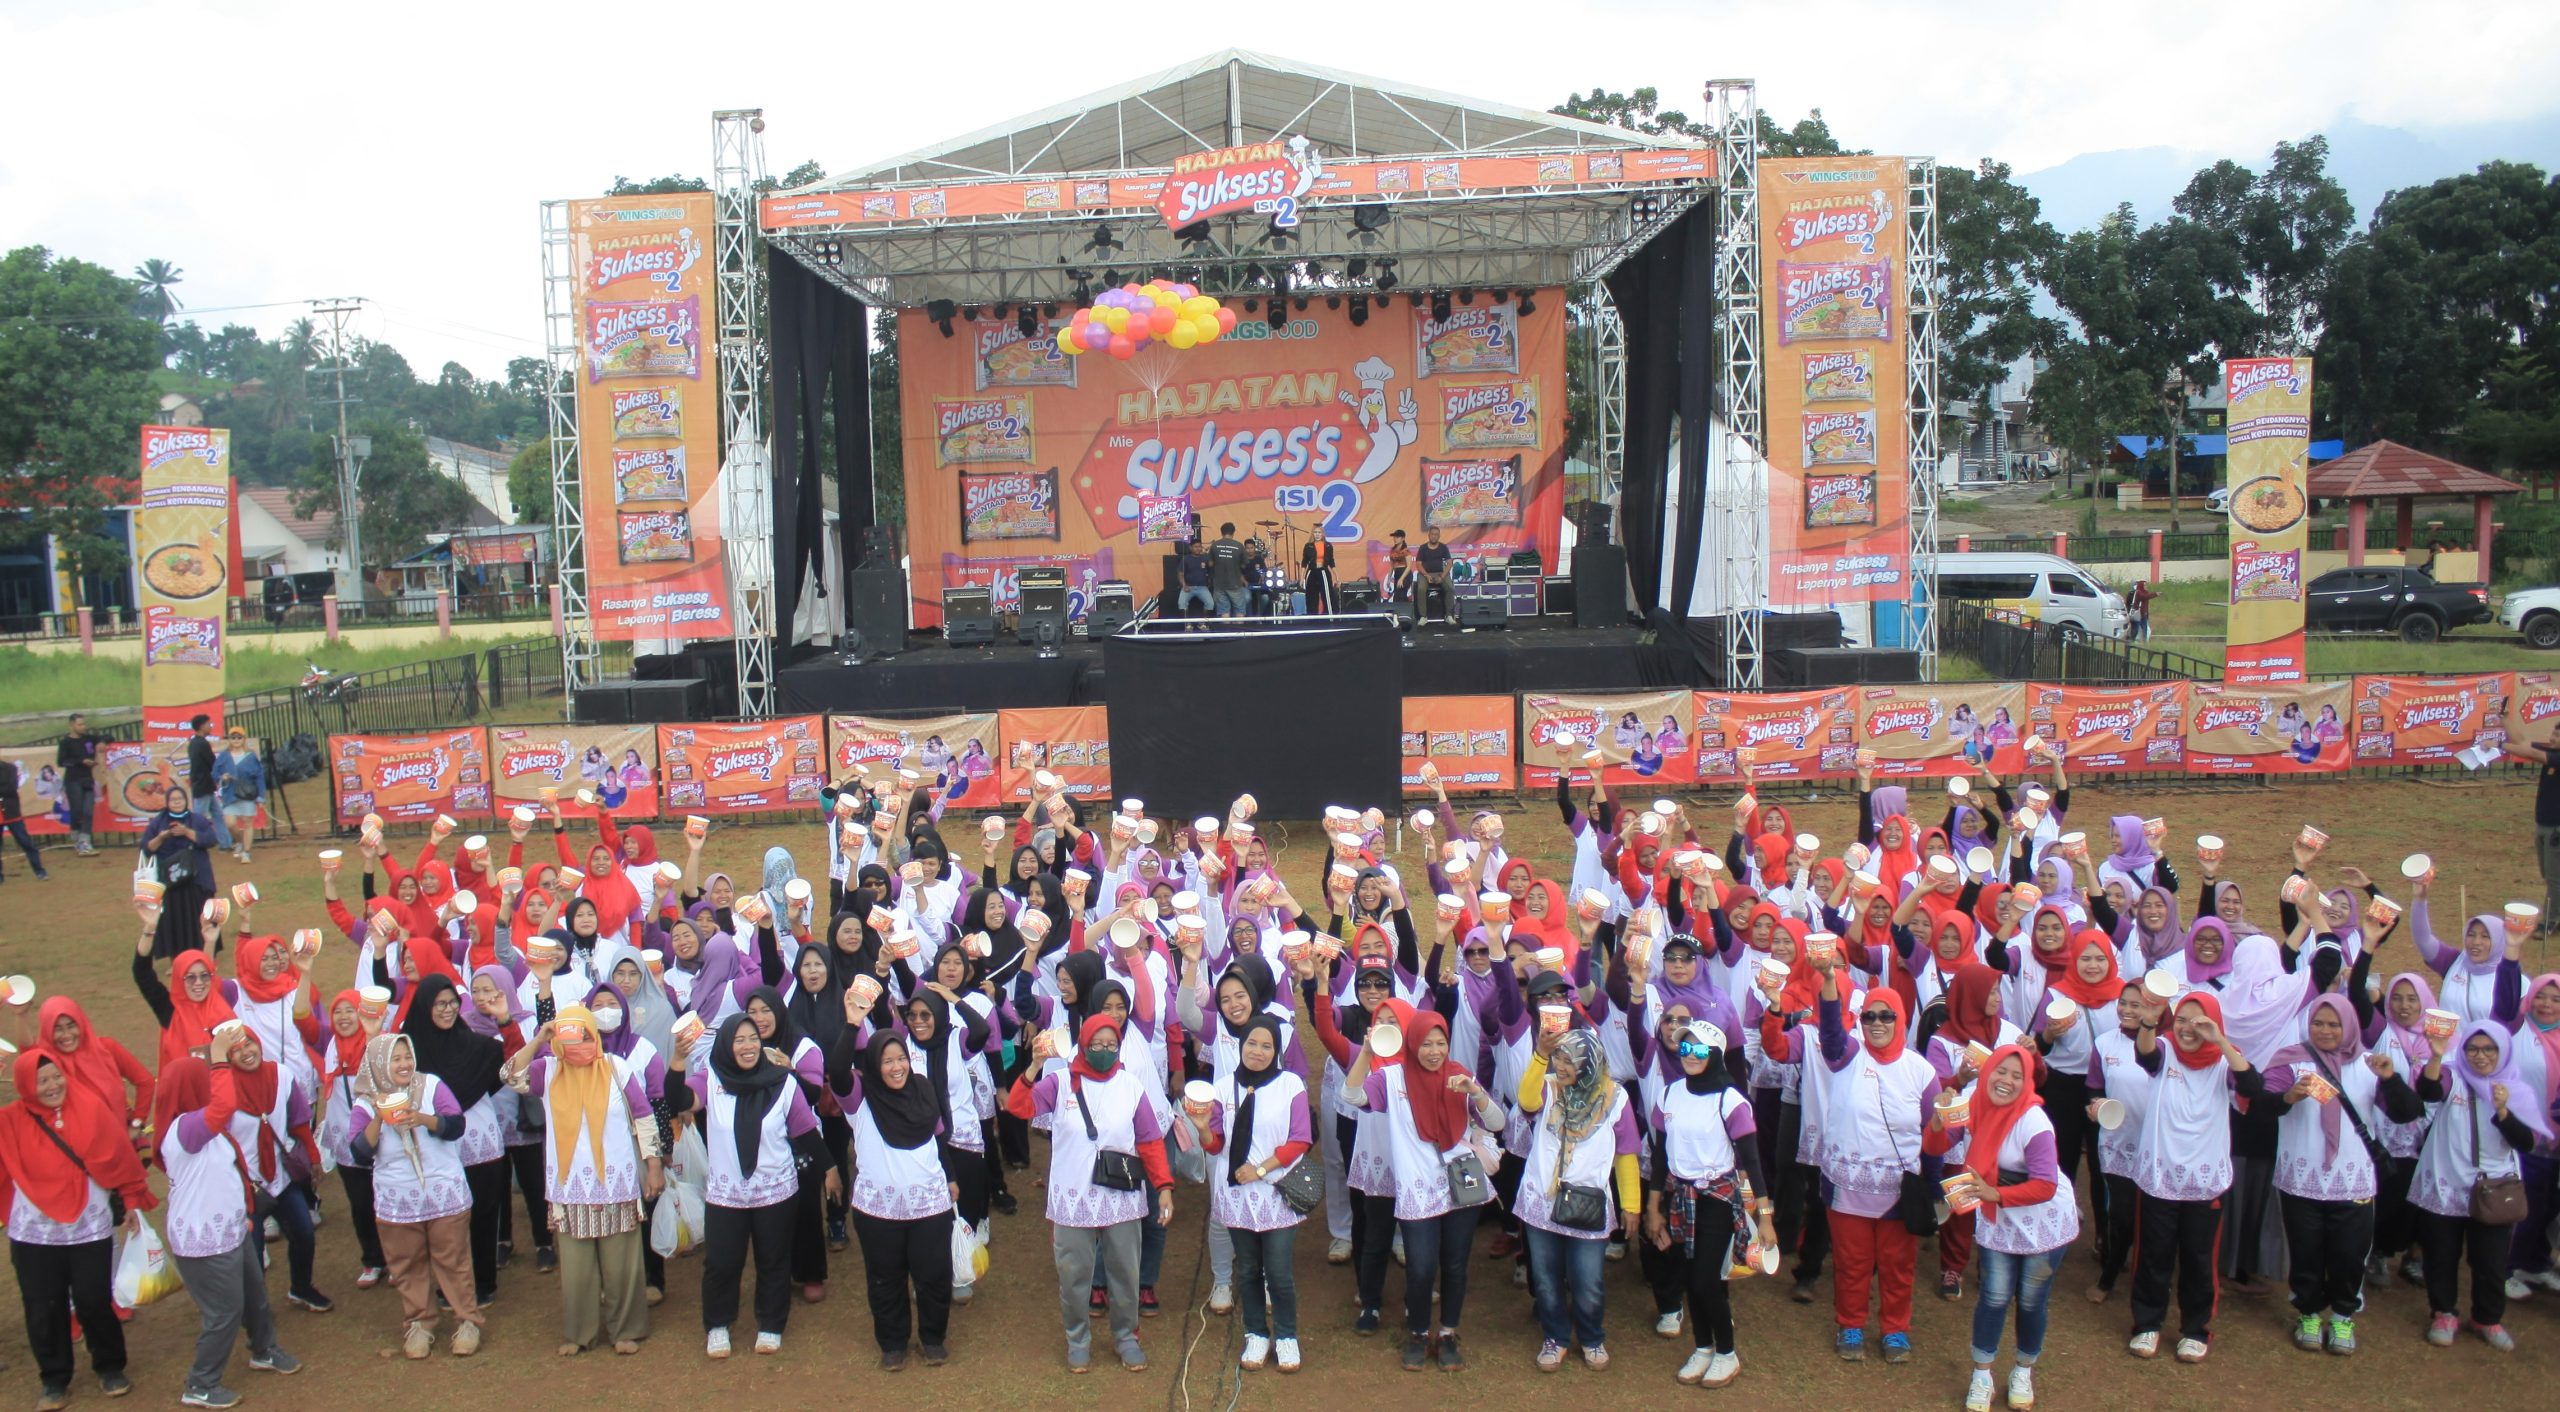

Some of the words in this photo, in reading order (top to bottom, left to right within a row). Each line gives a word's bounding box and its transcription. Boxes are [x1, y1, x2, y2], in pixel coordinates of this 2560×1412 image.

[1176, 144, 1283, 174] HAJATAN
[1809, 171, 1876, 182] WINGSFOOD
[1178, 168, 1284, 221] Sukses's
[1791, 196, 1865, 212] HAJATAN
[1256, 202, 1274, 211] ISI
[1277, 197, 1297, 225] 2
[1791, 211, 1868, 246] Sukses's
[598, 233, 673, 250] HAJATAN
[1862, 233, 1874, 253] 2
[598, 250, 674, 285] Sukses's
[652, 273, 664, 281] ISI
[667, 271, 680, 291] 2
[1786, 268, 1861, 306] Sukses's
[1791, 294, 1834, 319] MANTAAB
[1861, 287, 1875, 307] 2
[595, 305, 666, 345] Sukses's
[667, 325, 681, 345] 2
[600, 332, 638, 356] MANTAAB
[1470, 329, 1485, 337] ISI
[1487, 324, 1503, 347] 2
[1028, 341, 1043, 349] ISI
[1046, 338, 1061, 360] 2
[1806, 353, 1853, 380] Sukses's
[1853, 366, 1864, 383] 2
[2231, 364, 2289, 393] Sukses's
[2289, 378, 2299, 394] 2
[615, 389, 659, 417] Sukses's
[1118, 372, 1338, 426] HAJATAN
[1447, 386, 1509, 420] Sukses's
[660, 403, 671, 420] 2
[940, 402, 1003, 434] Sukses's
[1510, 401, 1526, 424] 2
[987, 421, 1000, 429] ISI
[1004, 417, 1019, 439] 2
[1807, 414, 1854, 441] Sukses's
[1855, 427, 1866, 444] 2
[147, 433, 207, 458] Sukses's
[1109, 436, 1133, 447] Mie
[206, 449, 217, 464] 2
[617, 451, 665, 477] Sukses's
[666, 464, 676, 481] 2
[1118, 419, 1341, 519] Sukses's
[1428, 463, 1493, 496] Sukses's
[1493, 480, 1506, 497] 2
[967, 476, 1030, 509] Sukses's
[1432, 485, 1468, 508] MANTAAB
[1809, 478, 1857, 503] Sukses's
[1856, 490, 1865, 504] 2
[968, 499, 1006, 521] MANTAAB
[1030, 493, 1044, 511] 2
[1279, 488, 1314, 507] ISI
[1322, 482, 1360, 539] 2
[623, 513, 671, 539] Sukses's
[671, 526, 681, 540] 2
[1781, 562, 1827, 574] Rasanya
[2236, 556, 2281, 580] Sukses's
[2280, 568, 2288, 581] 2
[1797, 577, 1846, 589] Lapernya
[1852, 571, 1899, 586] Beress
[601, 598, 646, 610] Rasanya
[617, 612, 666, 626] Lapernya
[672, 607, 720, 621] Beress
[199, 635, 207, 646] 2
[2228, 660, 2256, 668] Rasanya
[2236, 674, 2267, 682] Lapernya
[2205, 699, 2256, 707] HAJATAN
[2406, 694, 2455, 706] HAJATAN
[2531, 689, 2560, 698] HAJA
[1747, 710, 1800, 721] HAJATAN
[1876, 702, 1926, 712] HAJATAN
[2078, 703, 2129, 713] HAJATAN
[2404, 705, 2455, 729] Sukses's
[1875, 713, 1926, 735] Sukses's
[2076, 713, 2129, 737] Sukses's
[2204, 708, 2256, 730] Sukses's
[2449, 721, 2459, 734] 2
[846, 734, 895, 742] HAJATAN
[1746, 720, 1800, 745] Sukses's
[1920, 727, 1929, 739] 2
[2122, 728, 2132, 741] 2
[2250, 723, 2259, 736] 2
[510, 744, 557, 753] HAJATAN
[712, 741, 763, 753] HAJATAN
[1586, 736, 1595, 748] 2
[1795, 736, 1804, 749] 2
[381, 752, 431, 763] HAJATAN
[509, 754, 558, 775] Sukses's
[713, 751, 765, 777] Sukses's
[846, 744, 896, 765] Sukses's
[892, 758, 901, 770] 2
[382, 762, 432, 787] Sukses's
[428, 777, 437, 790] 2
[553, 769, 562, 781] 2
[760, 767, 770, 780] 2
[1464, 773, 1500, 782] Beress
